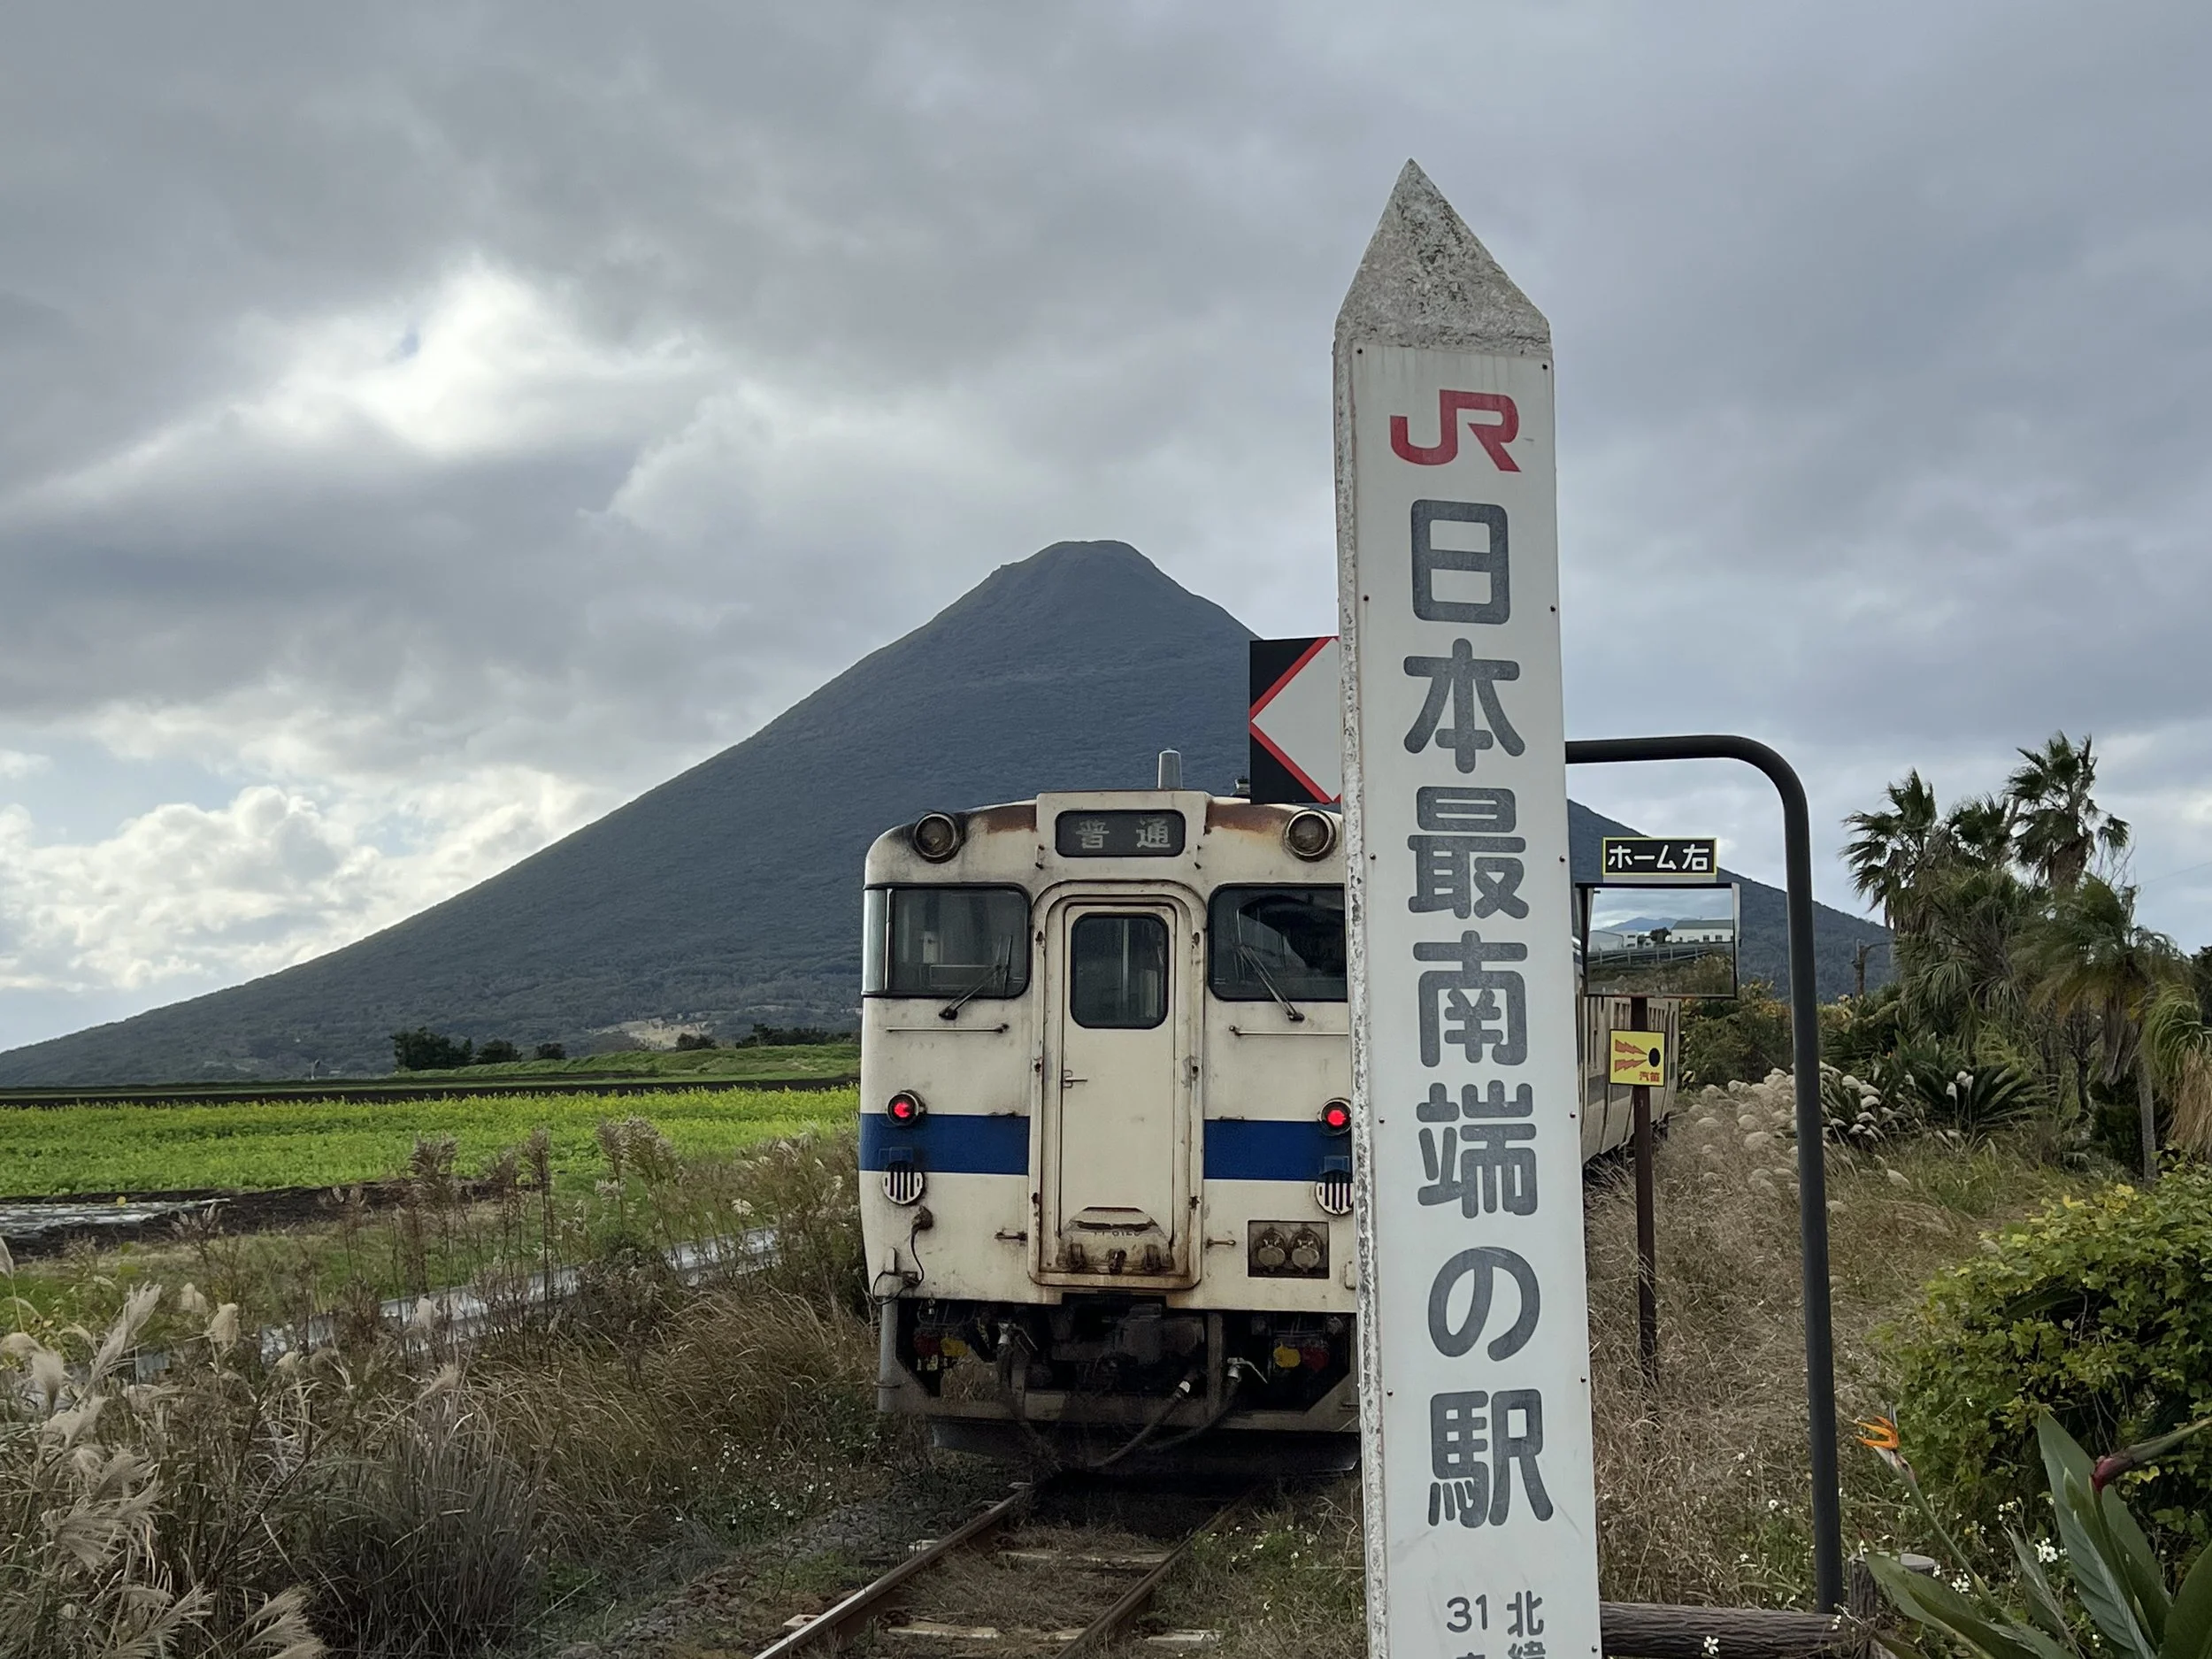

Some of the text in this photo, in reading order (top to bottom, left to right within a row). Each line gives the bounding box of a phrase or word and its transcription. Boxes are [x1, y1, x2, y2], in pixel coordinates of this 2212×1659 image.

[1390, 389, 1521, 472] JR
[1075, 818, 1171, 849] 普通
[1608, 843, 1709, 871] ホーム右
[1403, 499, 1554, 1528] 日本最南端の駅
[1447, 1594, 1487, 1659] 31
